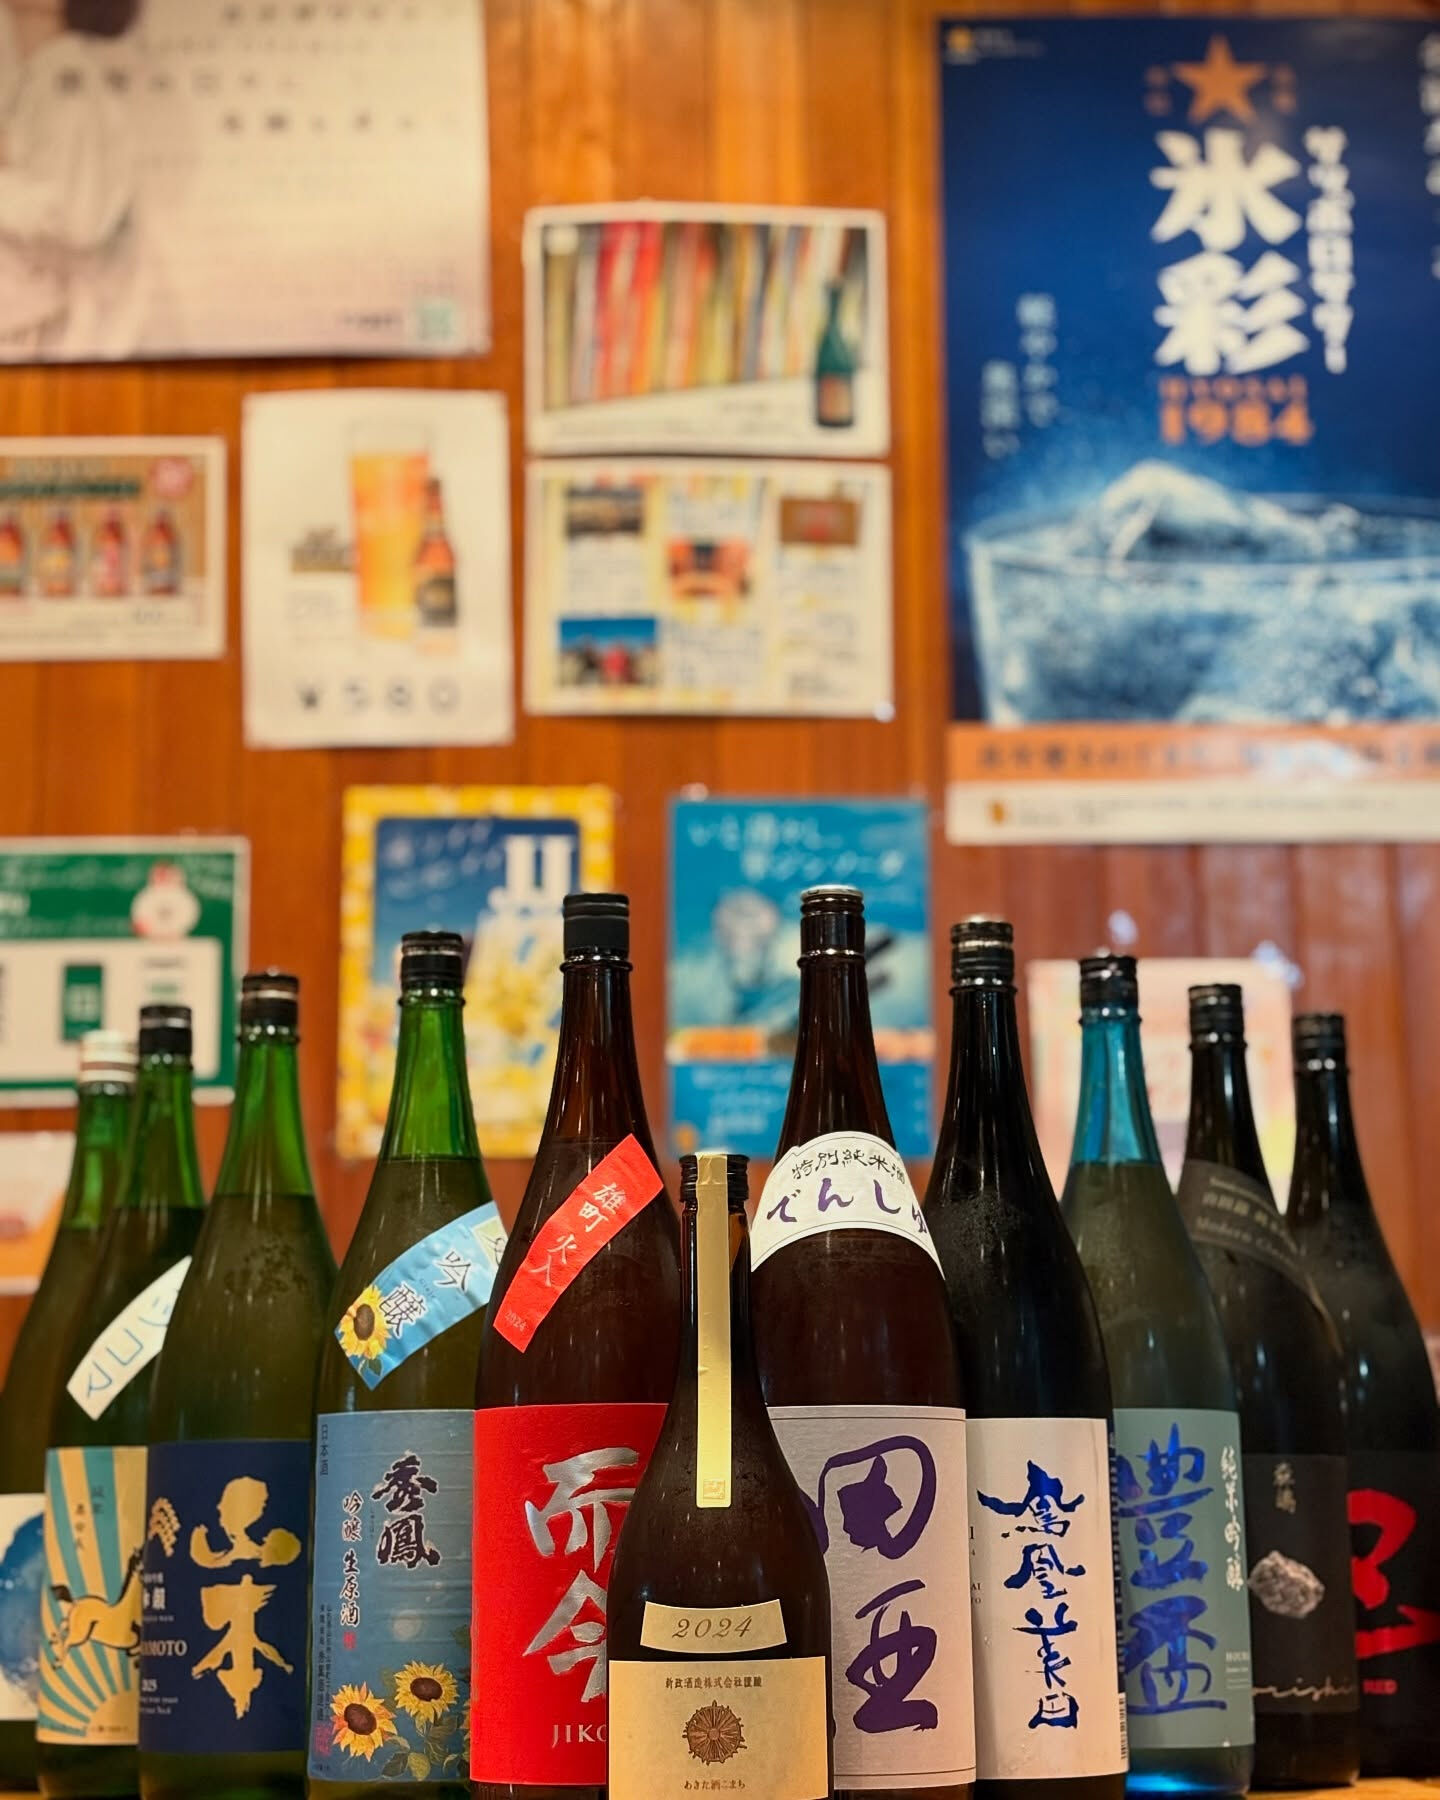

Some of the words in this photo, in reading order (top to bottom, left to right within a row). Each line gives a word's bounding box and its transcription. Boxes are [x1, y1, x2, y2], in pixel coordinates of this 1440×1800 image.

[1148, 126, 1309, 376] 氷彩
[1158, 399, 1314, 446] 1984
[791, 1149, 906, 1185] 特別純米酒
[370, 1452, 442, 1571] 秀鳳
[189, 1475, 302, 1720] 山本
[672, 1615, 752, 1638] 2024
